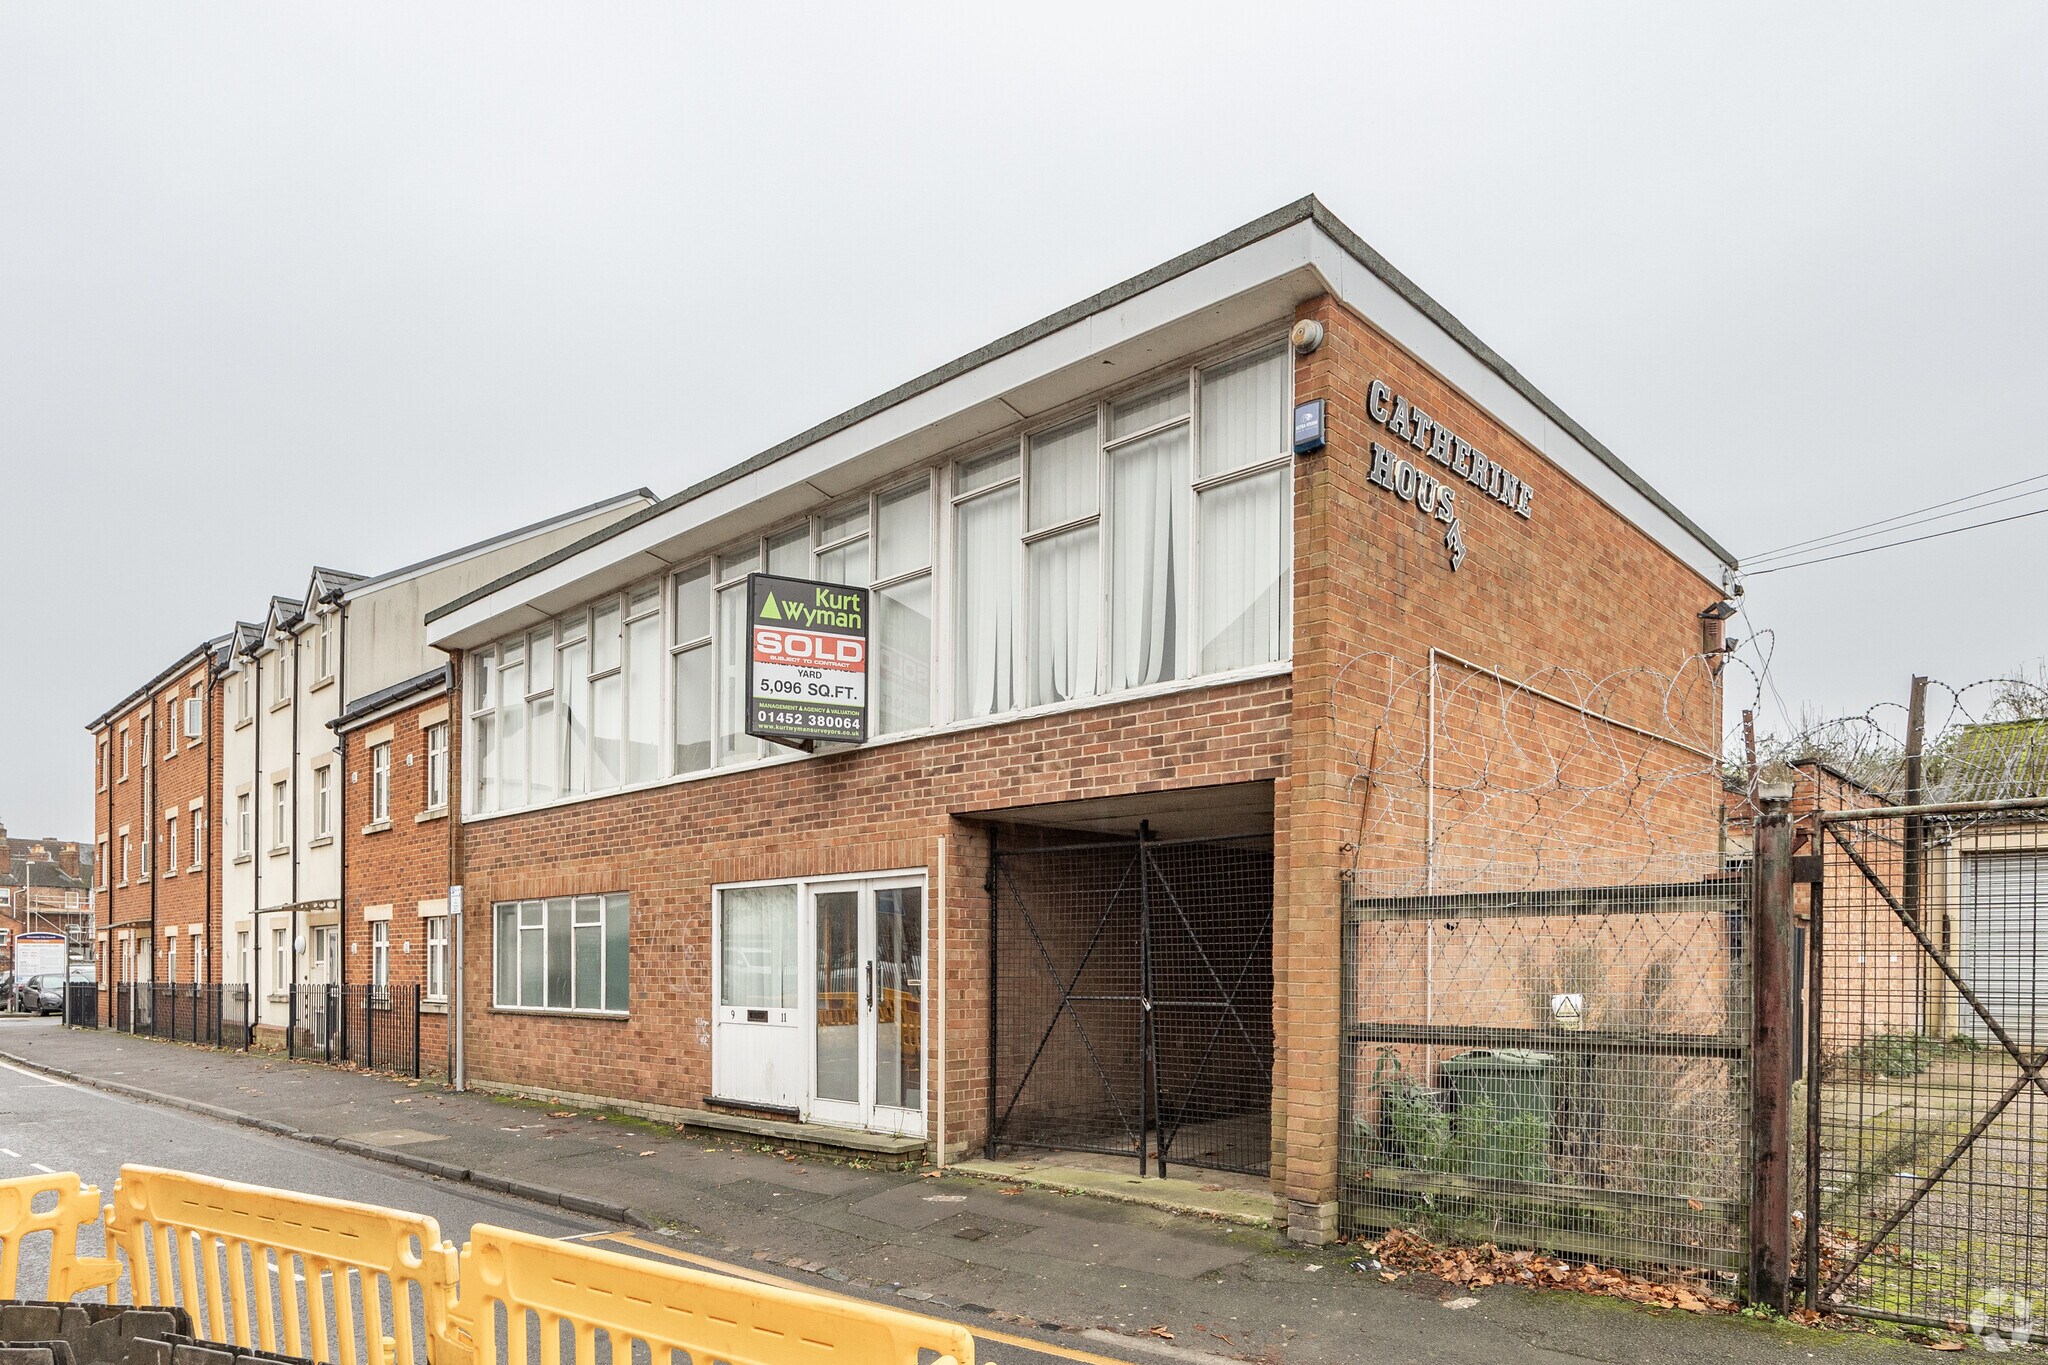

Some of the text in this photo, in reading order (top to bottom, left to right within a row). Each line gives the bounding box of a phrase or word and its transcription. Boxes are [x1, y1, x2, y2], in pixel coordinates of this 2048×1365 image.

[1366, 379, 1534, 521] CATHERINE
[815, 587, 861, 612] Kurt
[756, 631, 863, 663] SOLD
[769, 655, 801, 663] SUBJECT
[813, 660, 851, 668] CONTRACT
[797, 669, 822, 679] YARD
[760, 678, 858, 700] 5,096 SQ.FT.
[759, 702, 860, 717] MANAGEMENT AGENCY VALUATION
[757, 710, 860, 730] 01452 380064
[758, 724, 860, 736] www.kurtwymansurveyors.co.uk
[731, 1010, 786, 1022] 9 11
